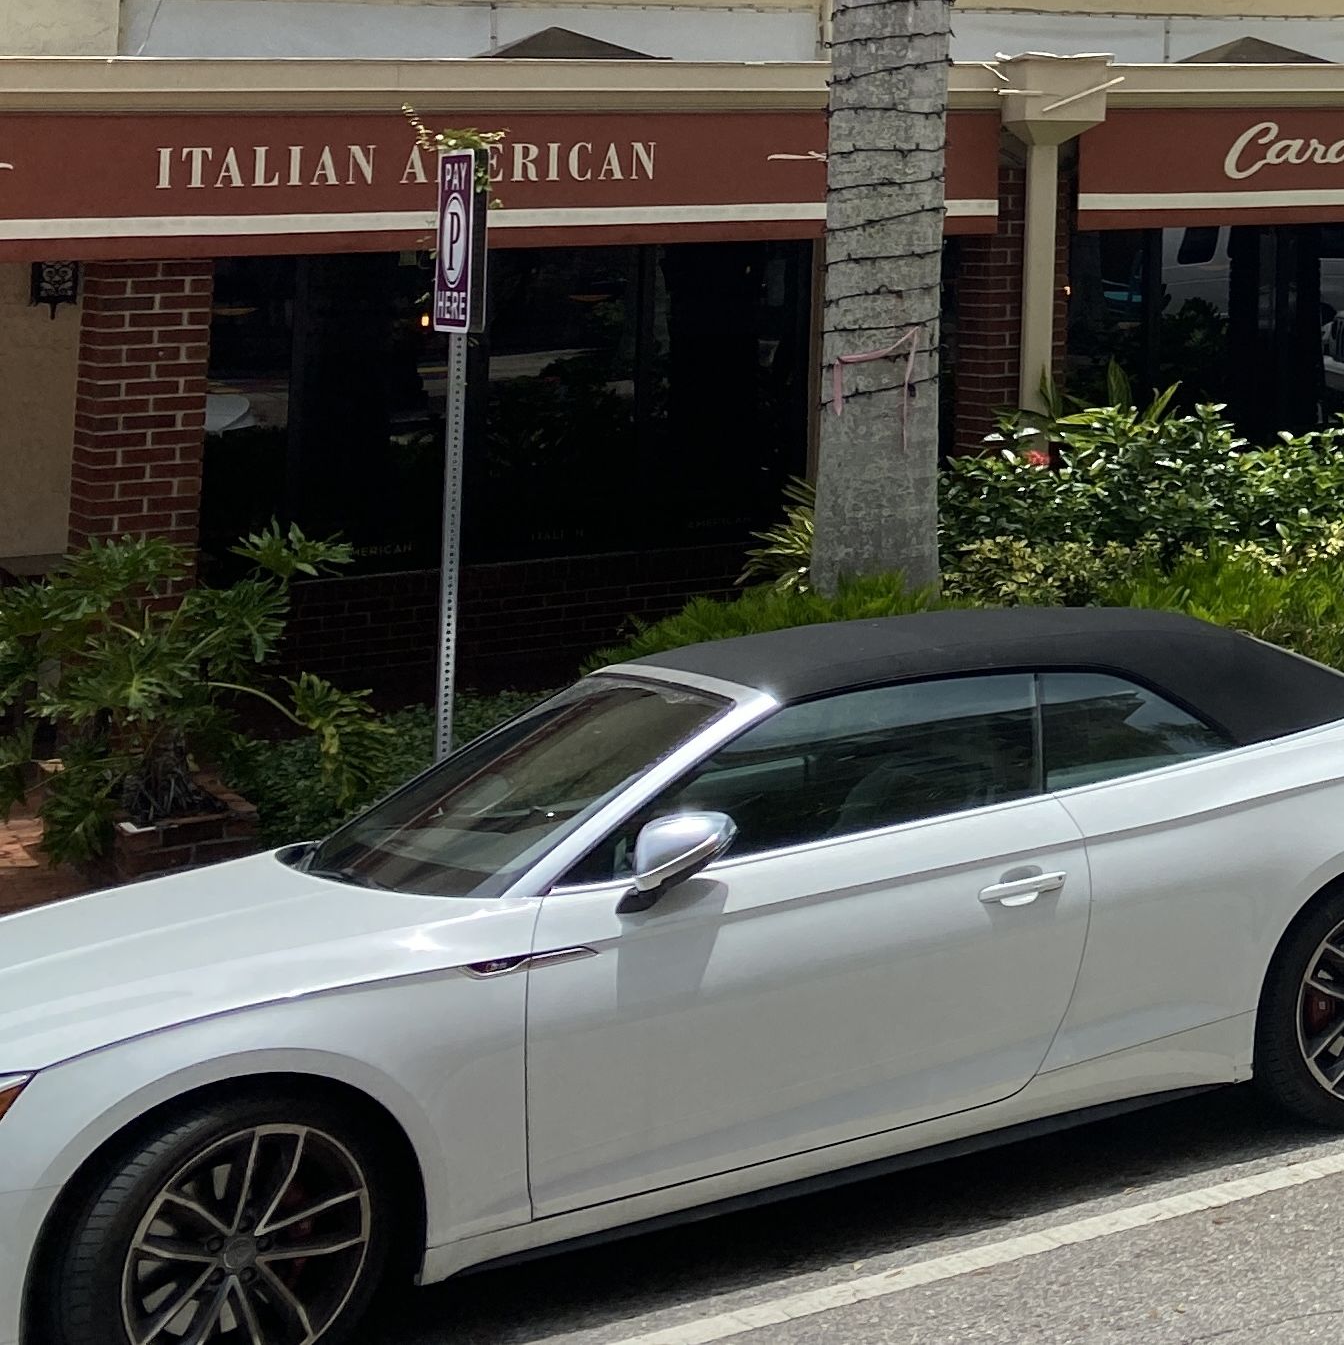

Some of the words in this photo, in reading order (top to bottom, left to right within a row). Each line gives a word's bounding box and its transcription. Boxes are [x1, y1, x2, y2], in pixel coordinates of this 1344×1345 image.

[155, 144, 376, 189] ITALIAN
[399, 141, 657, 185] AERICAN
[443, 161, 467, 191] PAY
[447, 211, 461, 271] P
[436, 290, 467, 321] HERE
